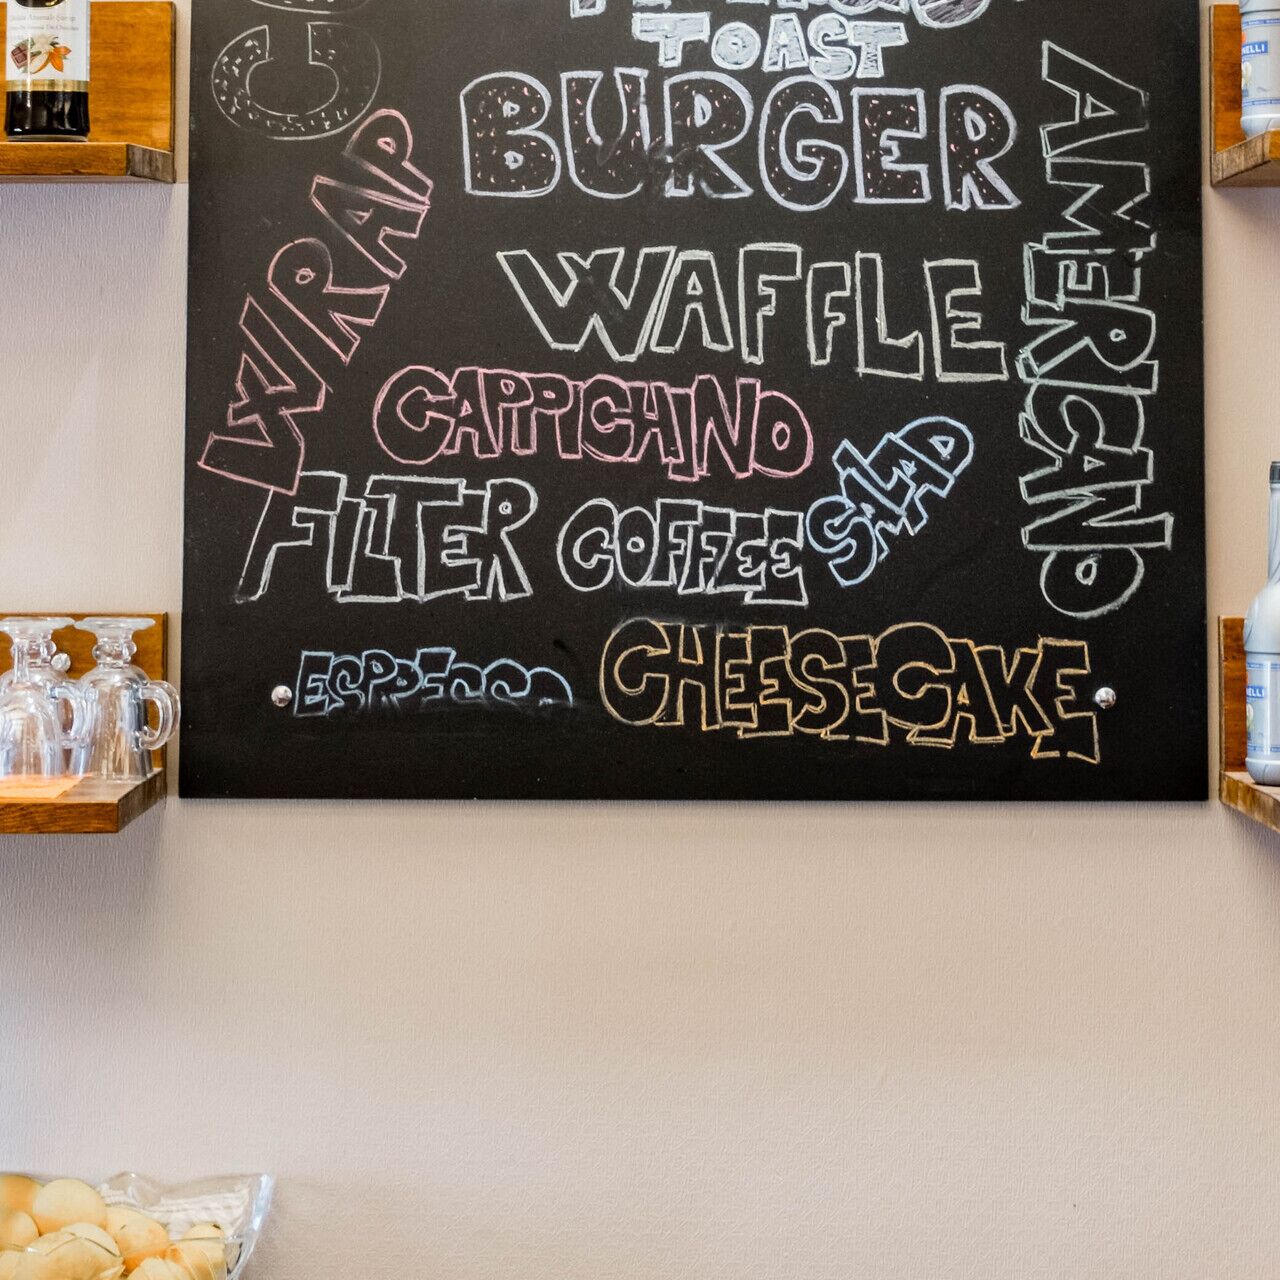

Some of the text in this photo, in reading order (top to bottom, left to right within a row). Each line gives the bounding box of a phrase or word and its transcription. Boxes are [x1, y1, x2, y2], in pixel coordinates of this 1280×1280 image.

[631, 12, 909, 79] TOAST
[459, 66, 1022, 212] BURGER
[496, 242, 1010, 383] WAFFLE
[233, 468, 809, 607] FILTER COFFEE
[599, 616, 1101, 764] CHEESECAKE
